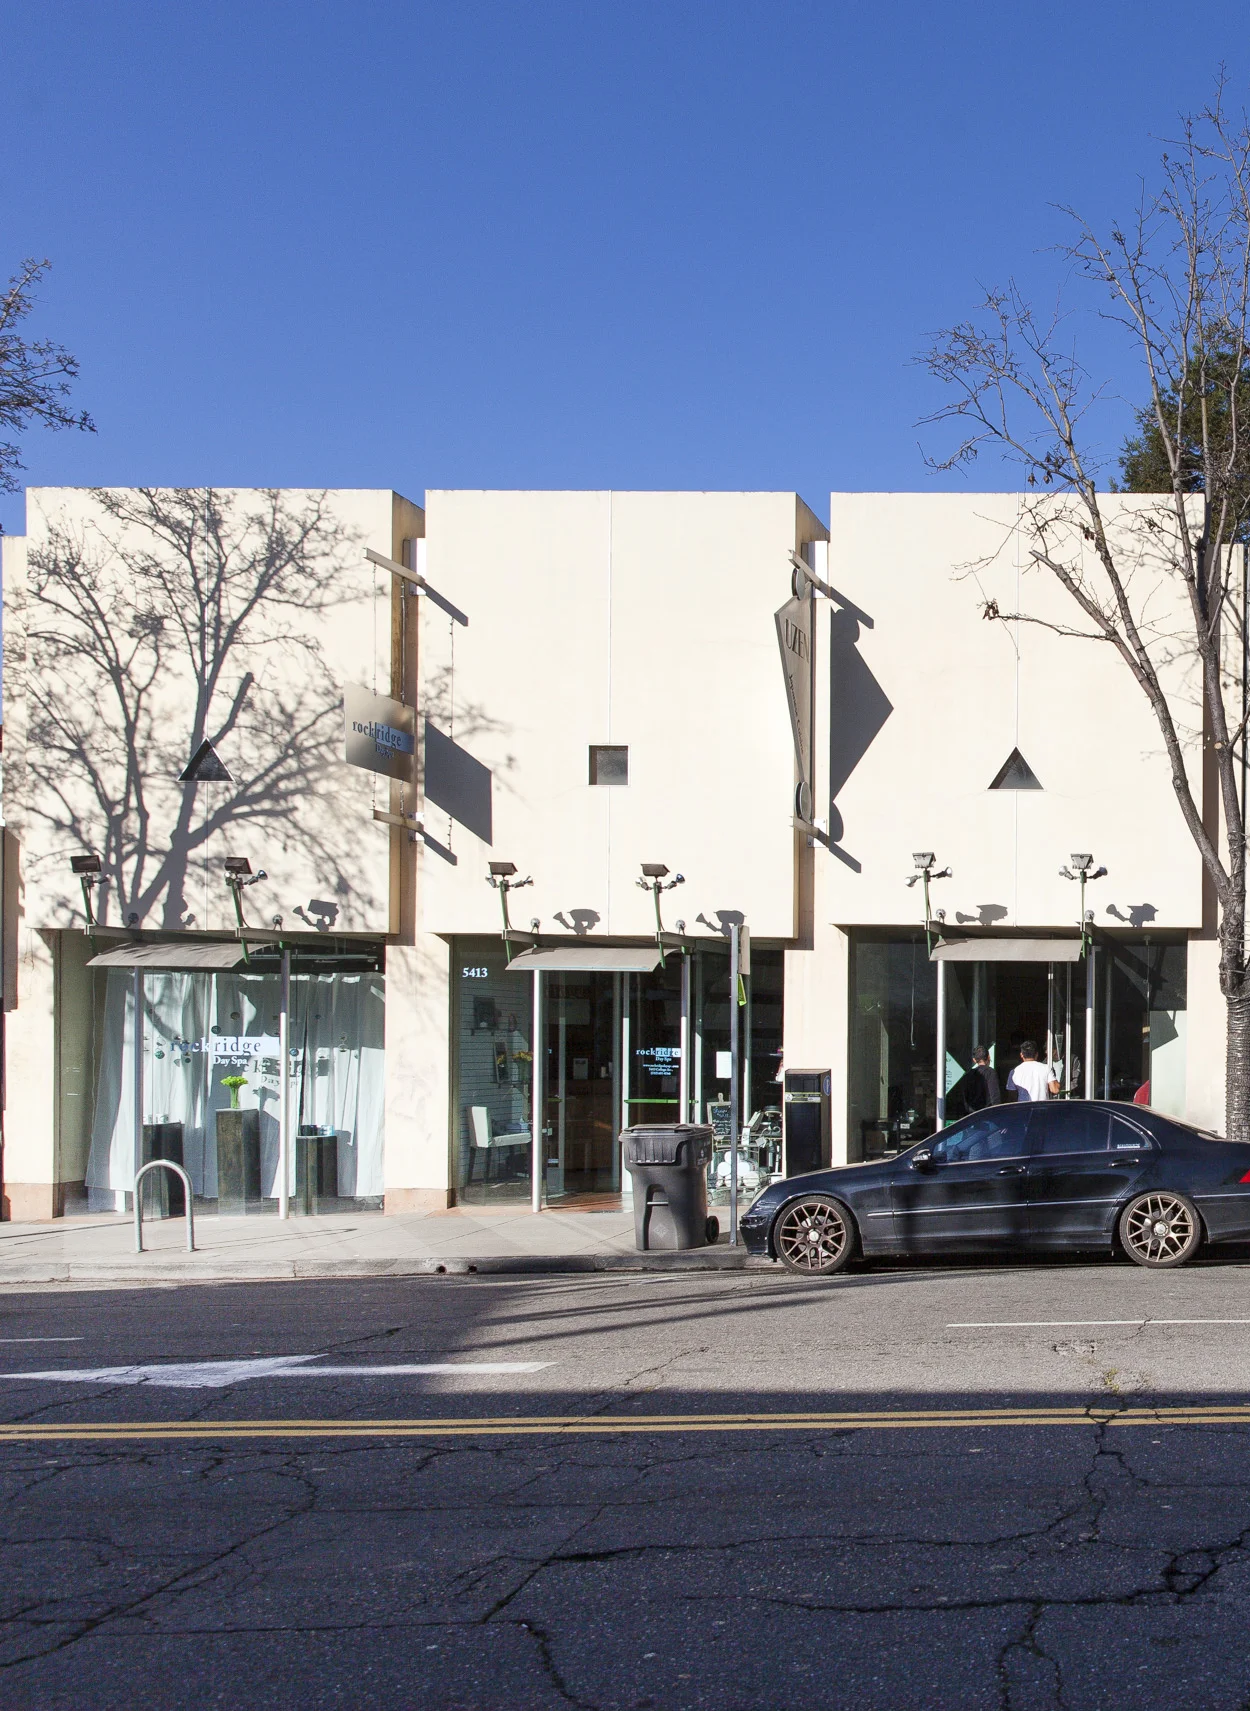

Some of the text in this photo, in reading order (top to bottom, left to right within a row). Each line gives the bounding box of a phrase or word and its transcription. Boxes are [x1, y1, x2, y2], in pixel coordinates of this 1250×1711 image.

[785, 618, 809, 664] UZEN
[352, 721, 402, 749] rockridge
[462, 967, 488, 978] 5413
[170, 1037, 261, 1056] rockridge
[213, 1055, 230, 1067] Day
[231, 1055, 247, 1067] Spa
